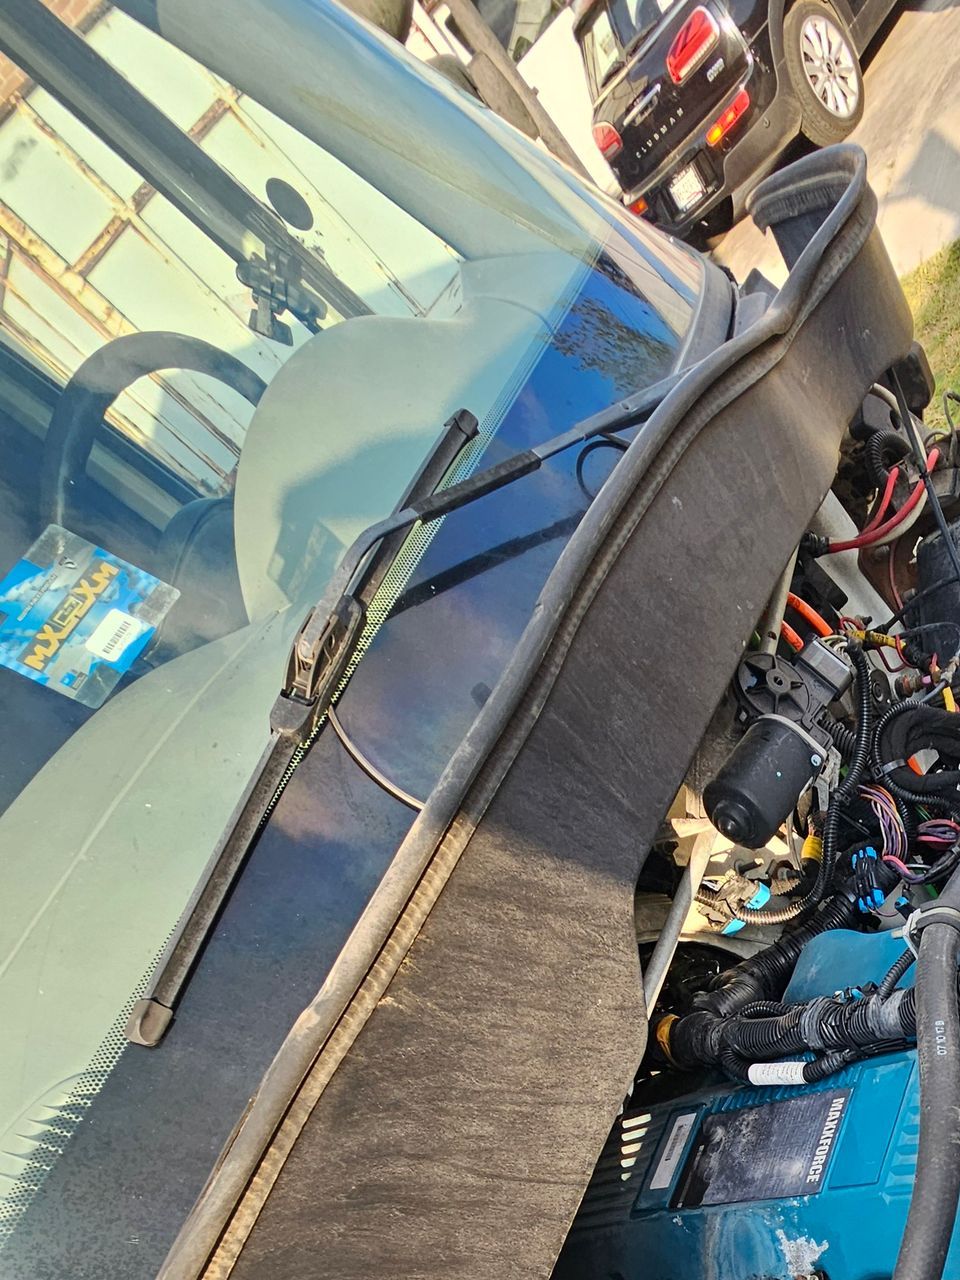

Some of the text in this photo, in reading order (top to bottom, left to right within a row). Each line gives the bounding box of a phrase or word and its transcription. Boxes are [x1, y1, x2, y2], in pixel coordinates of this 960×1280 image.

[635, 107, 685, 159] CLUBMAN
[936, 1045, 948, 1056] 07
[806, 1097, 846, 1184] MAXXFORCE
